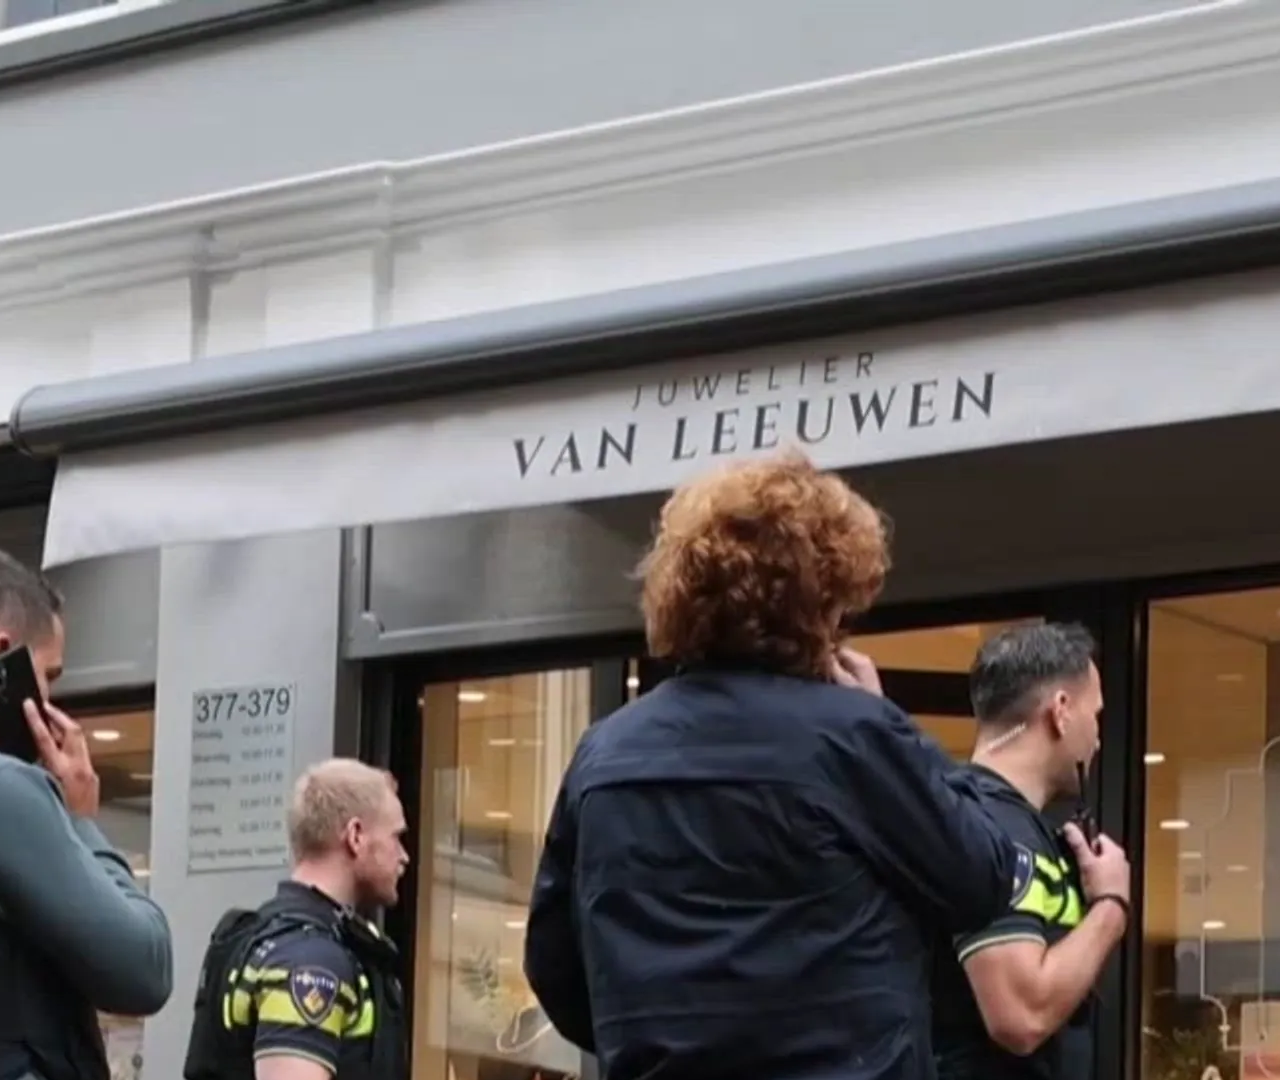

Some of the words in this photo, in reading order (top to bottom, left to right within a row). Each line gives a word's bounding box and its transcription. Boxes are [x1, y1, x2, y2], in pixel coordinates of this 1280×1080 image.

[632, 351, 875, 411] JUWELIER
[513, 422, 637, 480] VAN
[670, 371, 997, 463] LEEUWEN
[195, 686, 291, 724] 377-379
